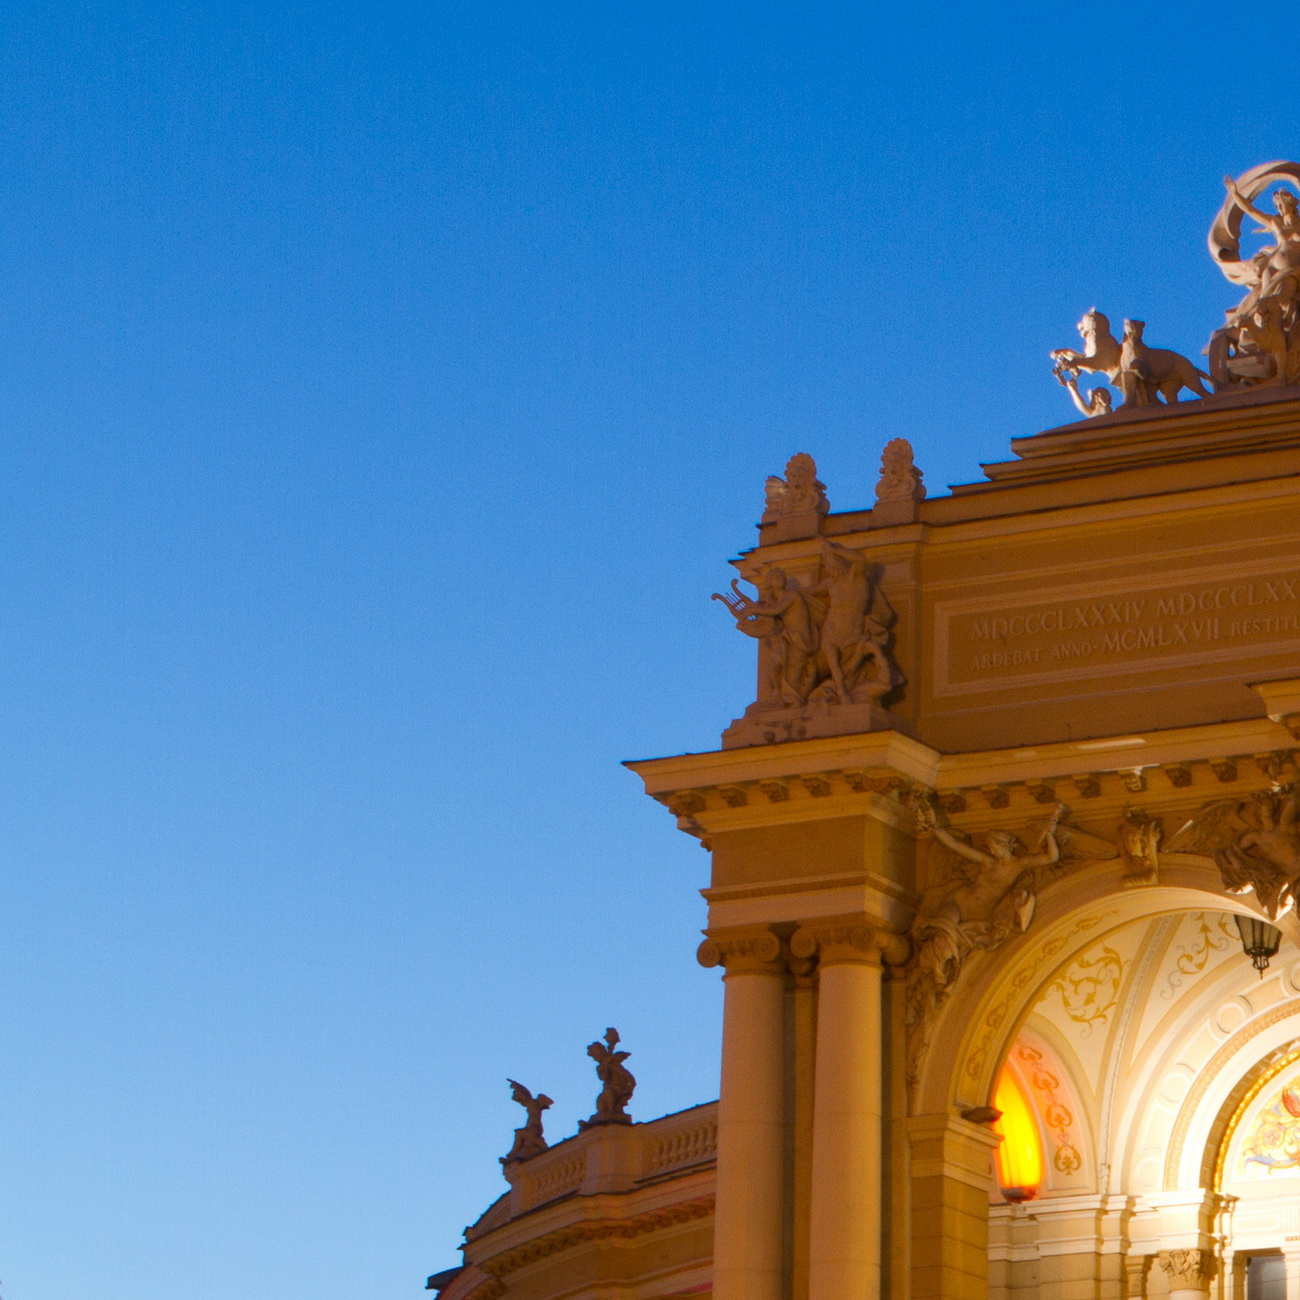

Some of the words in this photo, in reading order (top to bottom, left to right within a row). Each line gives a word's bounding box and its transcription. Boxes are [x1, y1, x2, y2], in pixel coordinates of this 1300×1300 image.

[971, 599, 1146, 642] MDCCCLXXXIV
[971, 647, 1044, 672] ARDEBAT
[1102, 618, 1220, 654] MCMLXVII
